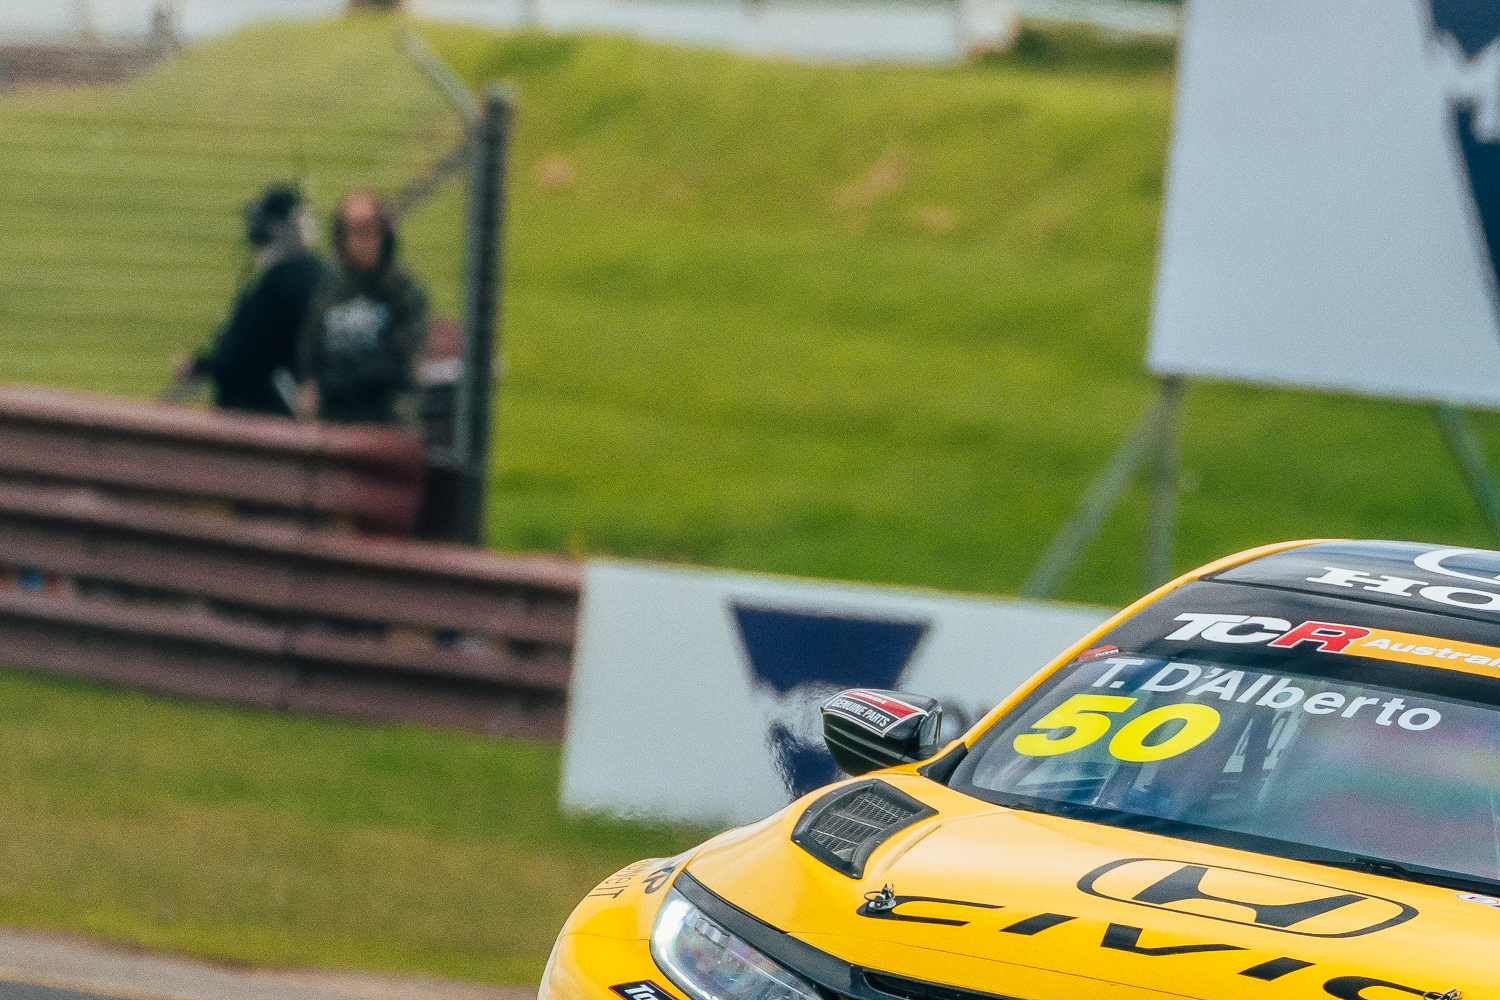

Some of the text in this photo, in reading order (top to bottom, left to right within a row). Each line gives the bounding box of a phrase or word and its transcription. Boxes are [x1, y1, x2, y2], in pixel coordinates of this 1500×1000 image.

[1165, 612, 1373, 654] TCR
[861, 708, 891, 728] PARTS
[1091, 657, 1441, 731] T. D'Alberto
[1013, 693, 1221, 762] 50
